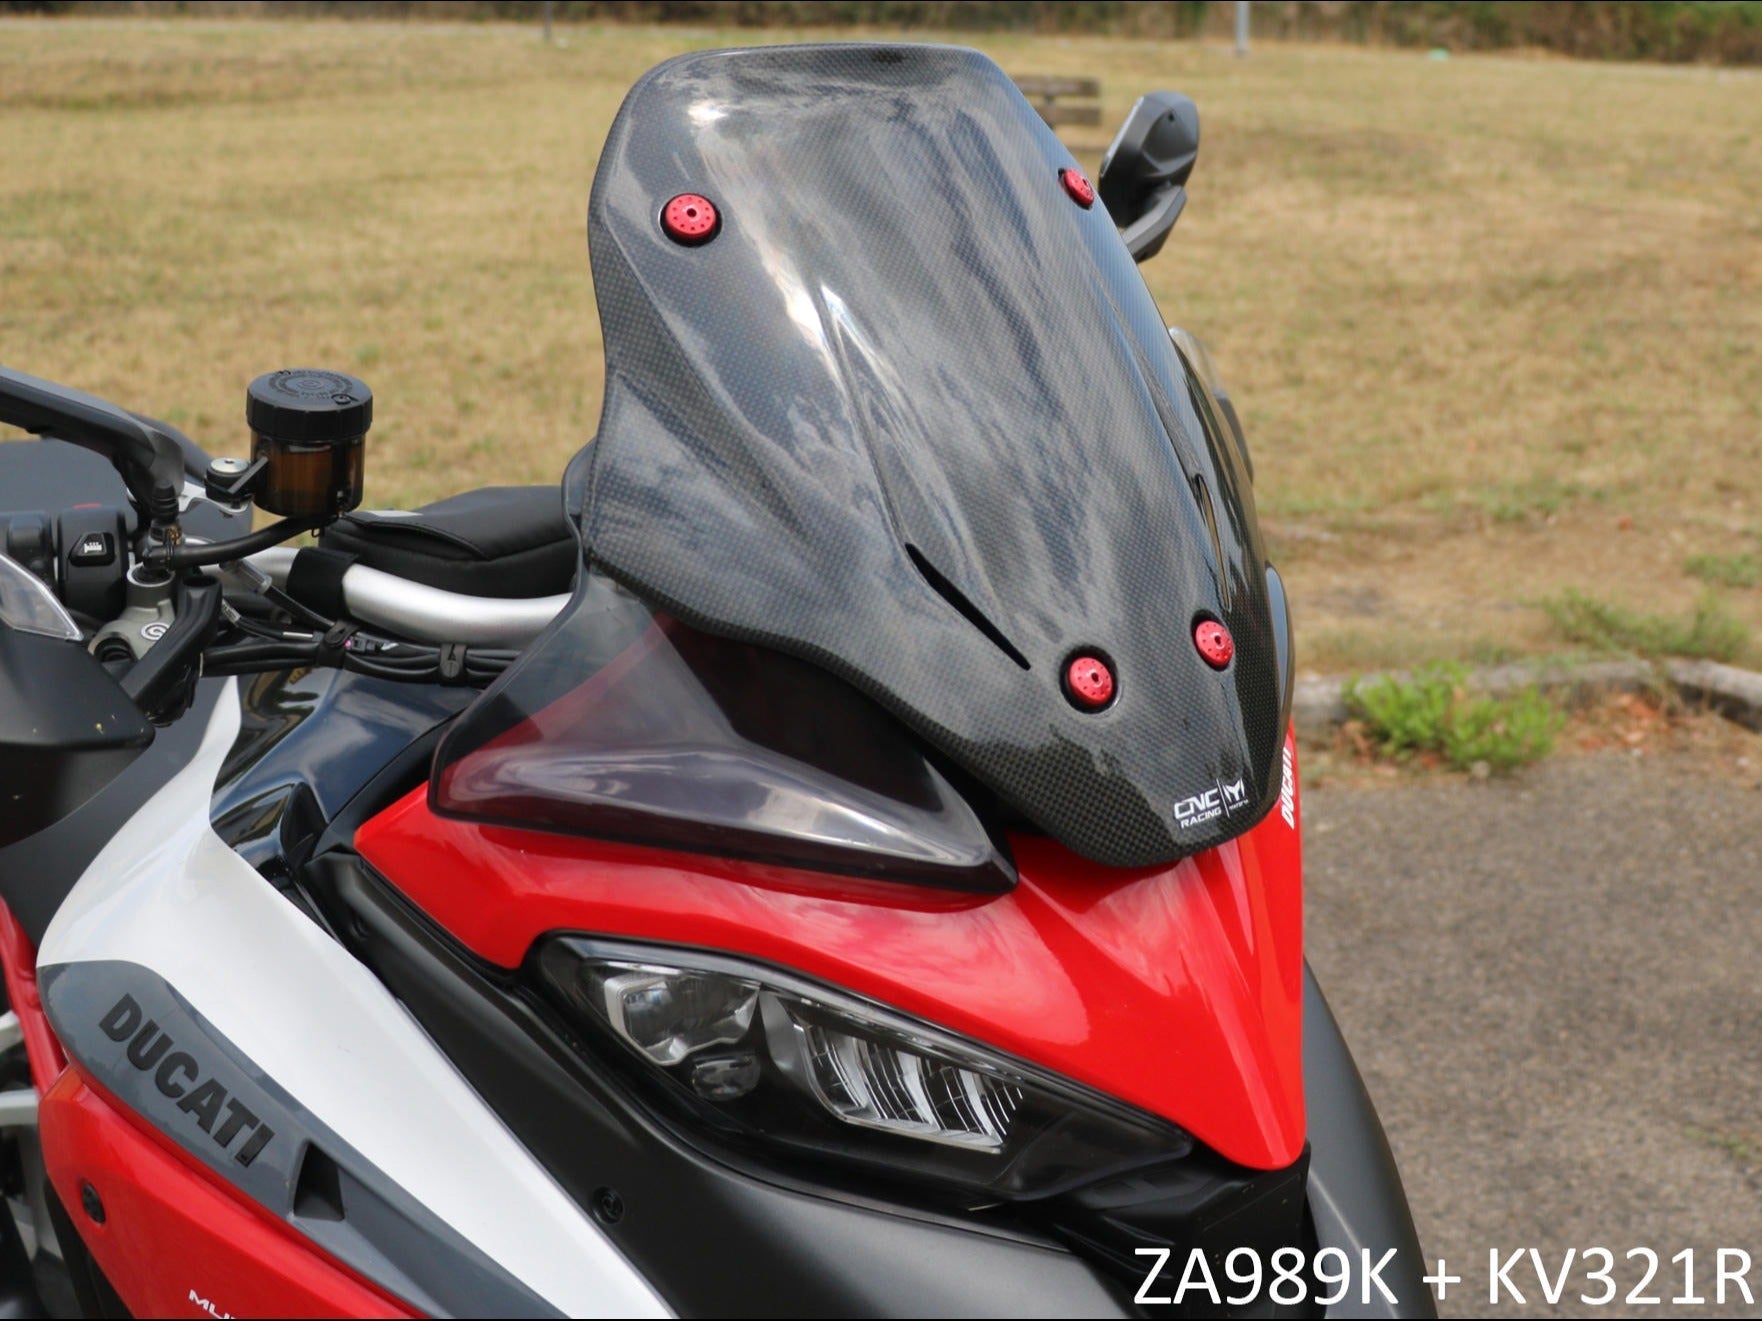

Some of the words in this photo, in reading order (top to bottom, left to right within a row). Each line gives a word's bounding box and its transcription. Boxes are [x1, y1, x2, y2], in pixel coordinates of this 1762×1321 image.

[1174, 788, 1220, 820] CNC
[1180, 806, 1222, 829] RACING
[98, 993, 275, 1168] DUCATI
